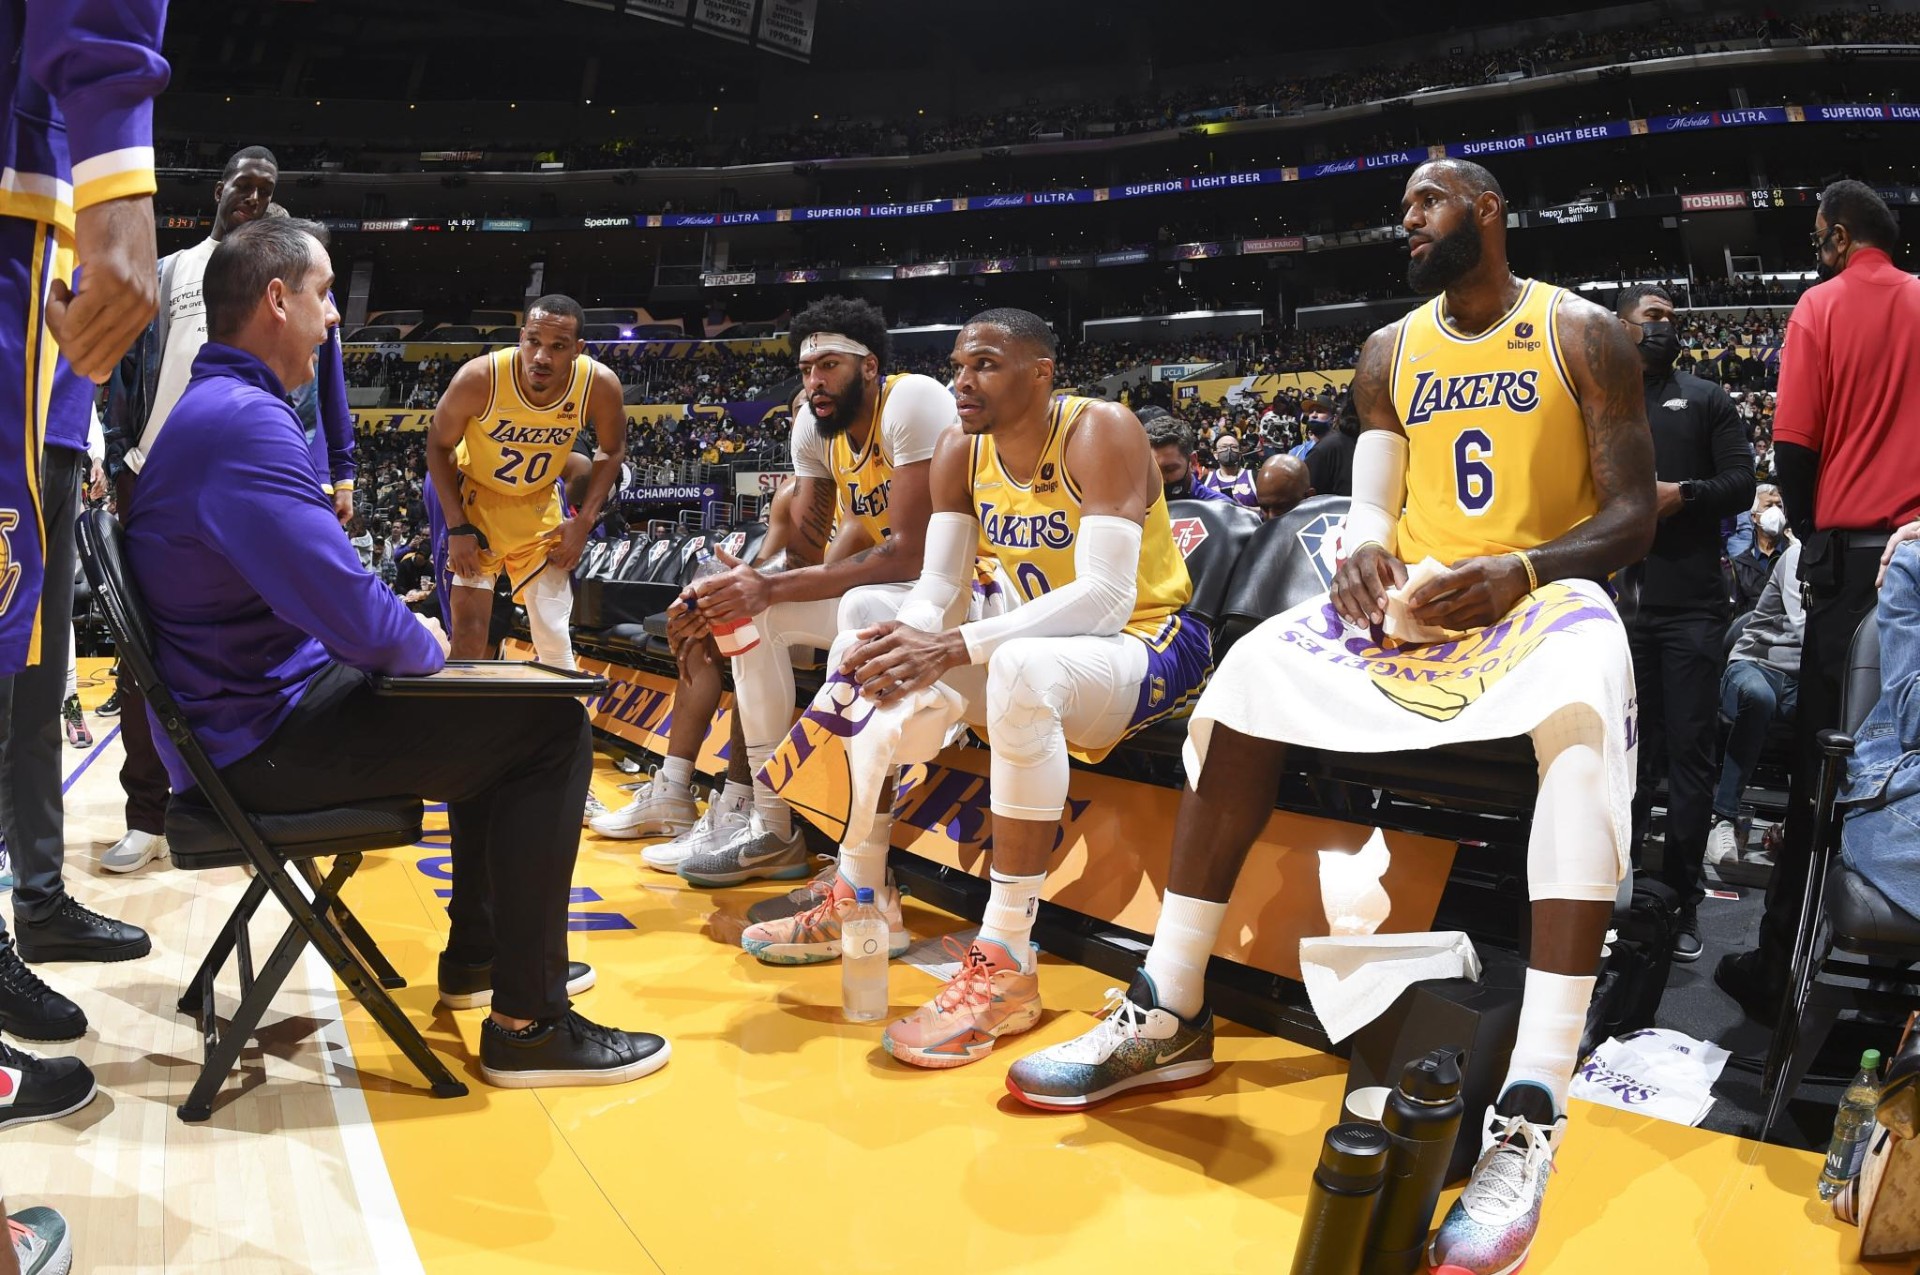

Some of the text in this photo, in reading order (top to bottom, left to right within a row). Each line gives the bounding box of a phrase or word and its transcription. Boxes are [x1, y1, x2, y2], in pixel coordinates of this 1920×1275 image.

[1666, 110, 1767, 130] Michelob ULTRA
[1821, 107, 1883, 118] SUPERIOR
[1463, 126, 1608, 155] SUPERIOR LIGHT BEER
[1315, 152, 1409, 176] Michelob ULTRA
[1125, 172, 1261, 196] SUPERIOR LIGHT BEER
[984, 192, 1075, 209] Michelob ULTRA
[1683, 194, 1745, 209] TOSHIBA
[1751, 190, 1769, 199] BOS
[806, 202, 934, 219] SUPERIOR LIGHT BEER
[1539, 204, 1599, 219] Happy Birthday
[1753, 200, 1769, 208] LAL
[584, 217, 629, 229] Spectrum
[723, 212, 760, 224] ULTRA
[1274, 240, 1300, 248] FARGO
[705, 274, 755, 285] STAPLES
[1507, 340, 1541, 352] bibigo
[1405, 369, 1540, 426] LAKERS
[488, 419, 574, 446] LAKERS
[493, 446, 552, 485] 20
[1454, 427, 1494, 513] 6
[636, 486, 700, 499] CHAMPIONS
[1035, 481, 1058, 494] bibigo
[979, 501, 1074, 550] LAKERS
[1278, 629, 1457, 684] ANGELES
